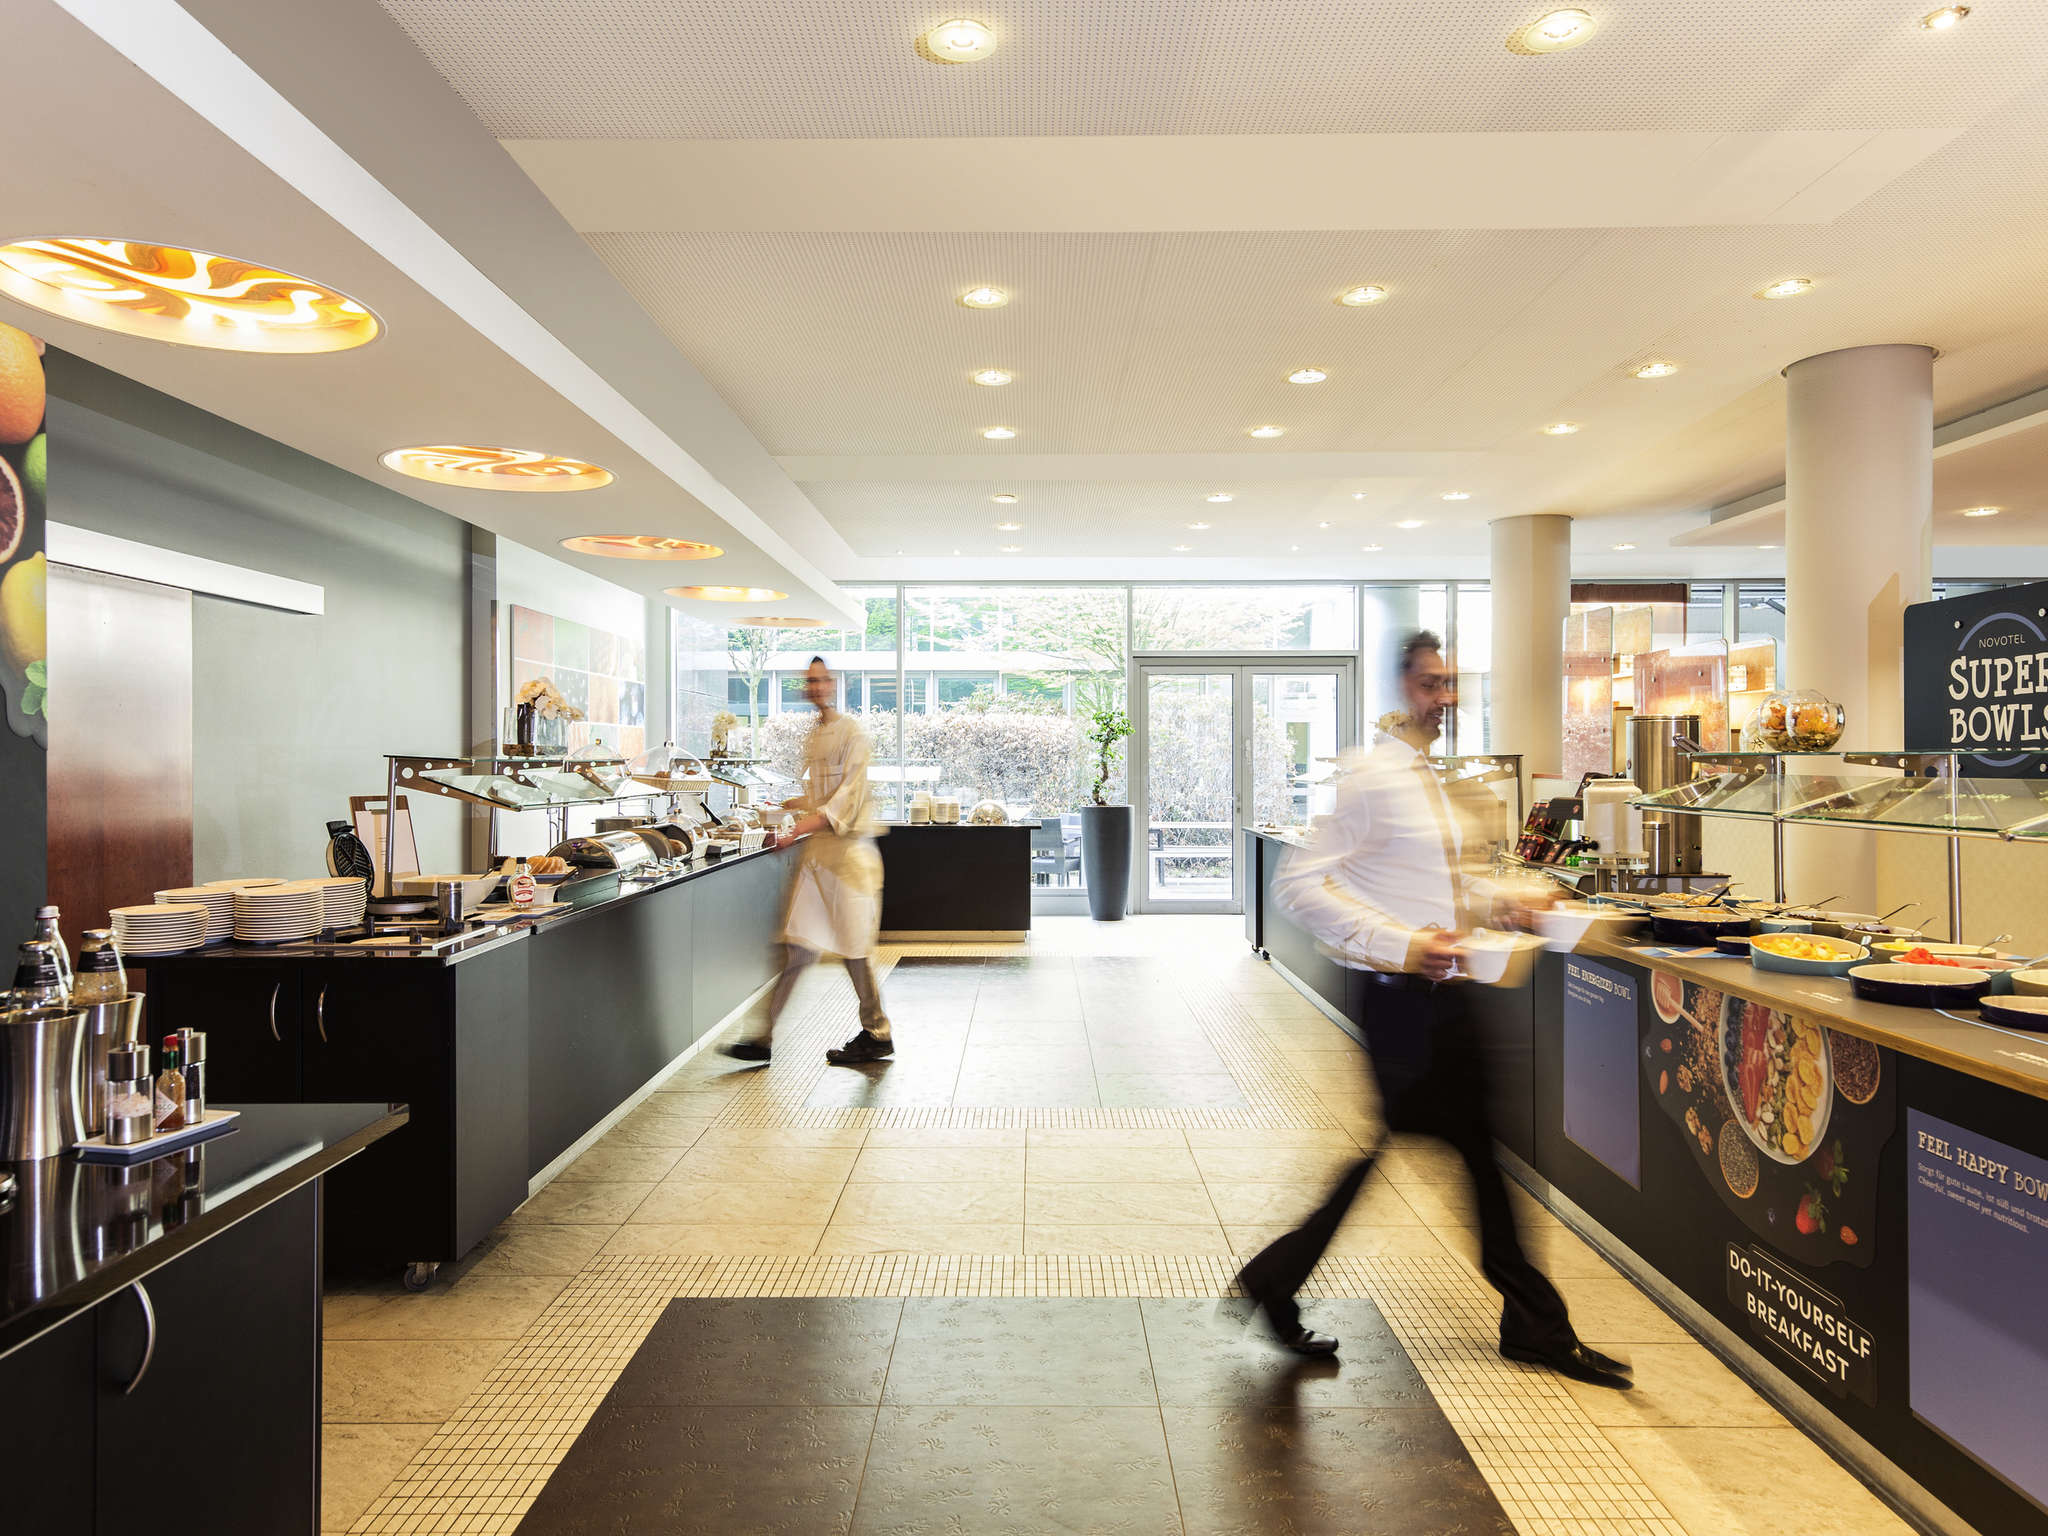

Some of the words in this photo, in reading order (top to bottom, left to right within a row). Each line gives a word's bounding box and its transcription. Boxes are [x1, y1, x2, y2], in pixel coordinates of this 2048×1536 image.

[1979, 634, 2026, 648] NOVOTEL
[1949, 652, 2048, 700] SUPER
[1918, 1130, 1952, 1160] FEEL
[1956, 1147, 2009, 1184] HAPPY
[1729, 1249, 1871, 1359] DO-IT-YOURSELF
[1747, 1291, 1849, 1381] BREAKFAST
